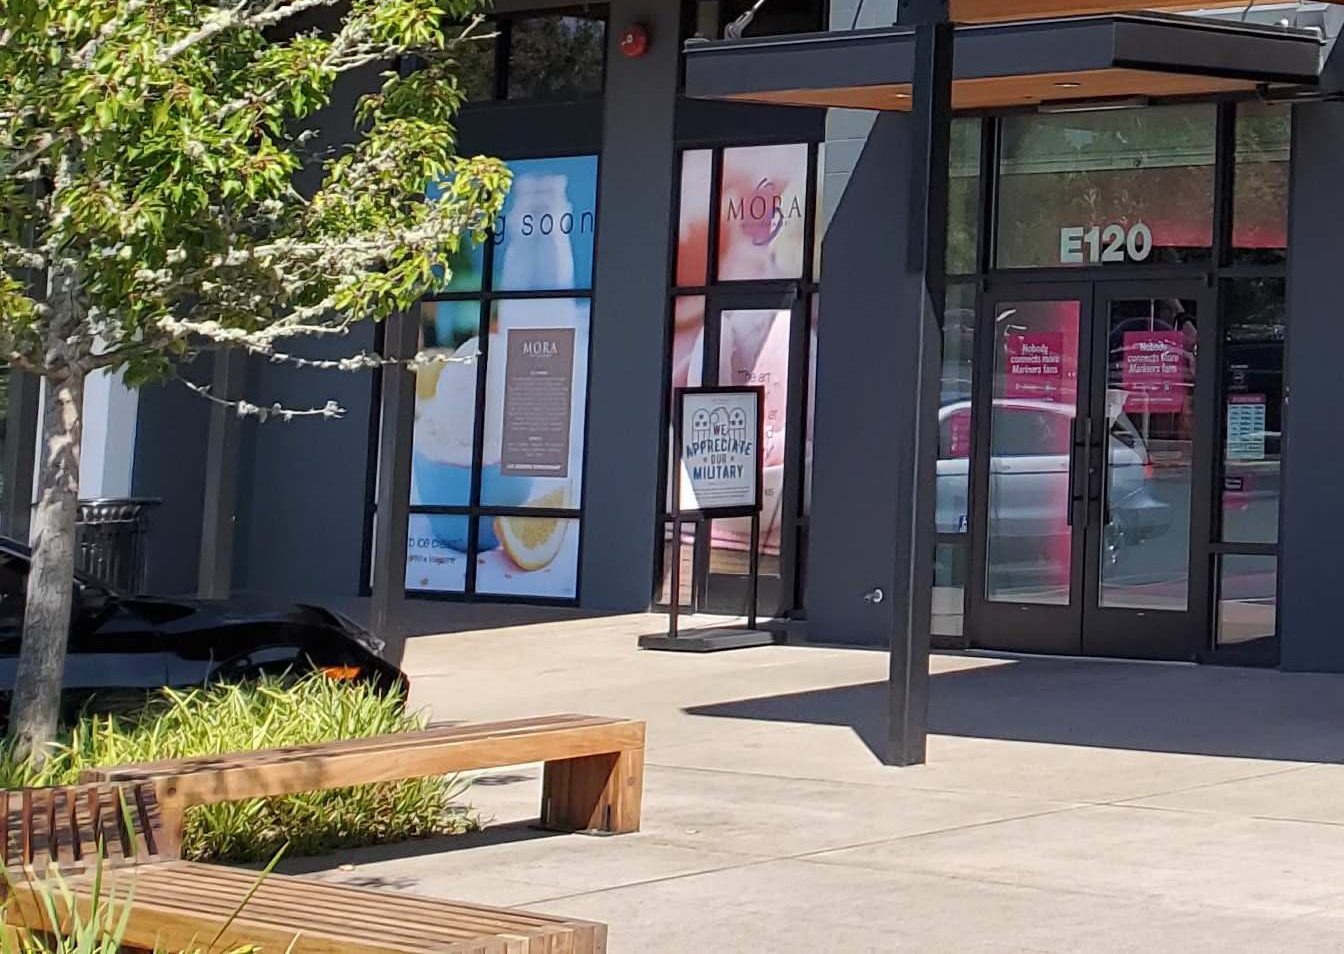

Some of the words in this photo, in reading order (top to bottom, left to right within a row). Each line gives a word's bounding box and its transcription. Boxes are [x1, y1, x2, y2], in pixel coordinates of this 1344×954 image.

[727, 195, 802, 221] MORA
[521, 211, 595, 236] soon
[1060, 222, 1153, 263] E120
[523, 341, 558, 354] MORA
[713, 424, 728, 436] WE
[687, 437, 753, 458] APPRECIATE
[711, 453, 727, 465] OUR
[693, 464, 744, 480] MILITARY
